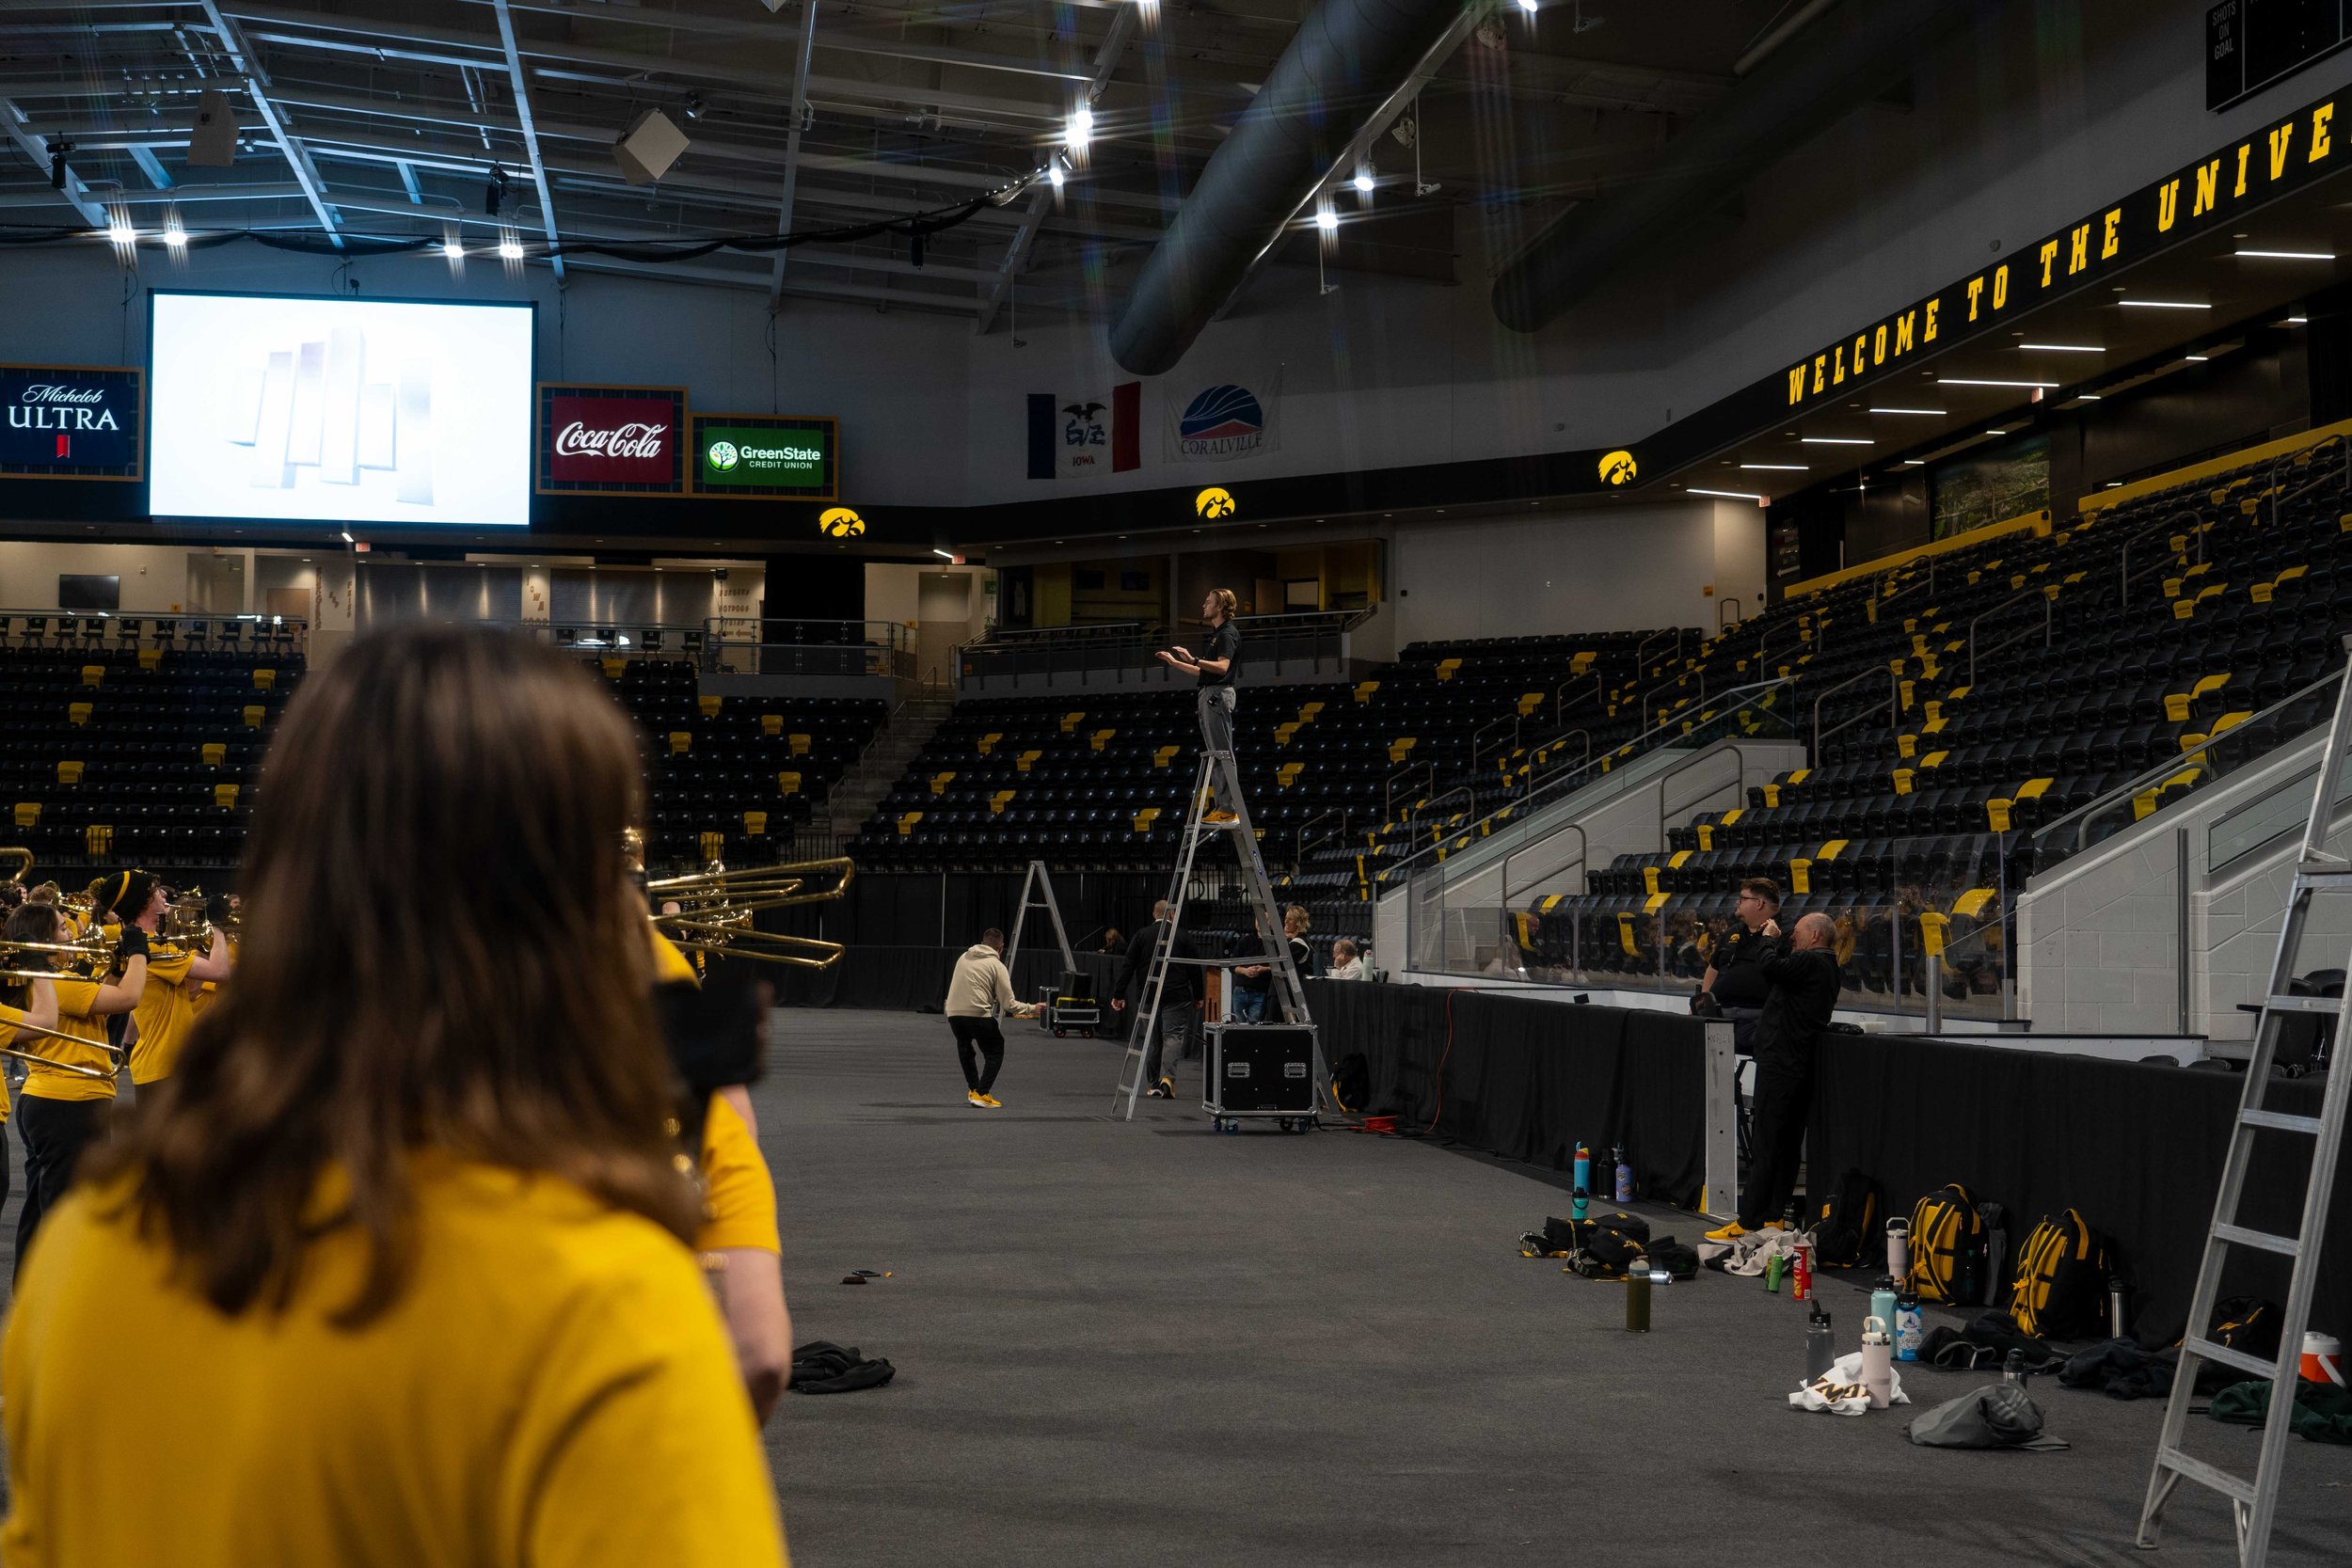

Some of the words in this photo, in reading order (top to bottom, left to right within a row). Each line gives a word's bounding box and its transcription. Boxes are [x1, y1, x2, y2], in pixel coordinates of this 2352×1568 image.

[2212, 1, 2235, 26] SHOTS
[2218, 22, 2230, 40] ON
[2214, 39, 2234, 60] GOAL
[1789, 299, 1939, 404] WELCOME
[1968, 265, 2008, 322] TO
[2041, 209, 2121, 287] THE
[2158, 103, 2352, 232] UNIVE
[23, 384, 104, 403] Michelob
[8, 405, 119, 430] ULTRA
[556, 421, 668, 458] Coca-Cola
[1181, 433, 1263, 454] CORALVILLE
[740, 445, 821, 460] GreenState
[1073, 455, 1095, 467] IOWA
[749, 460, 782, 468] CREDIT
